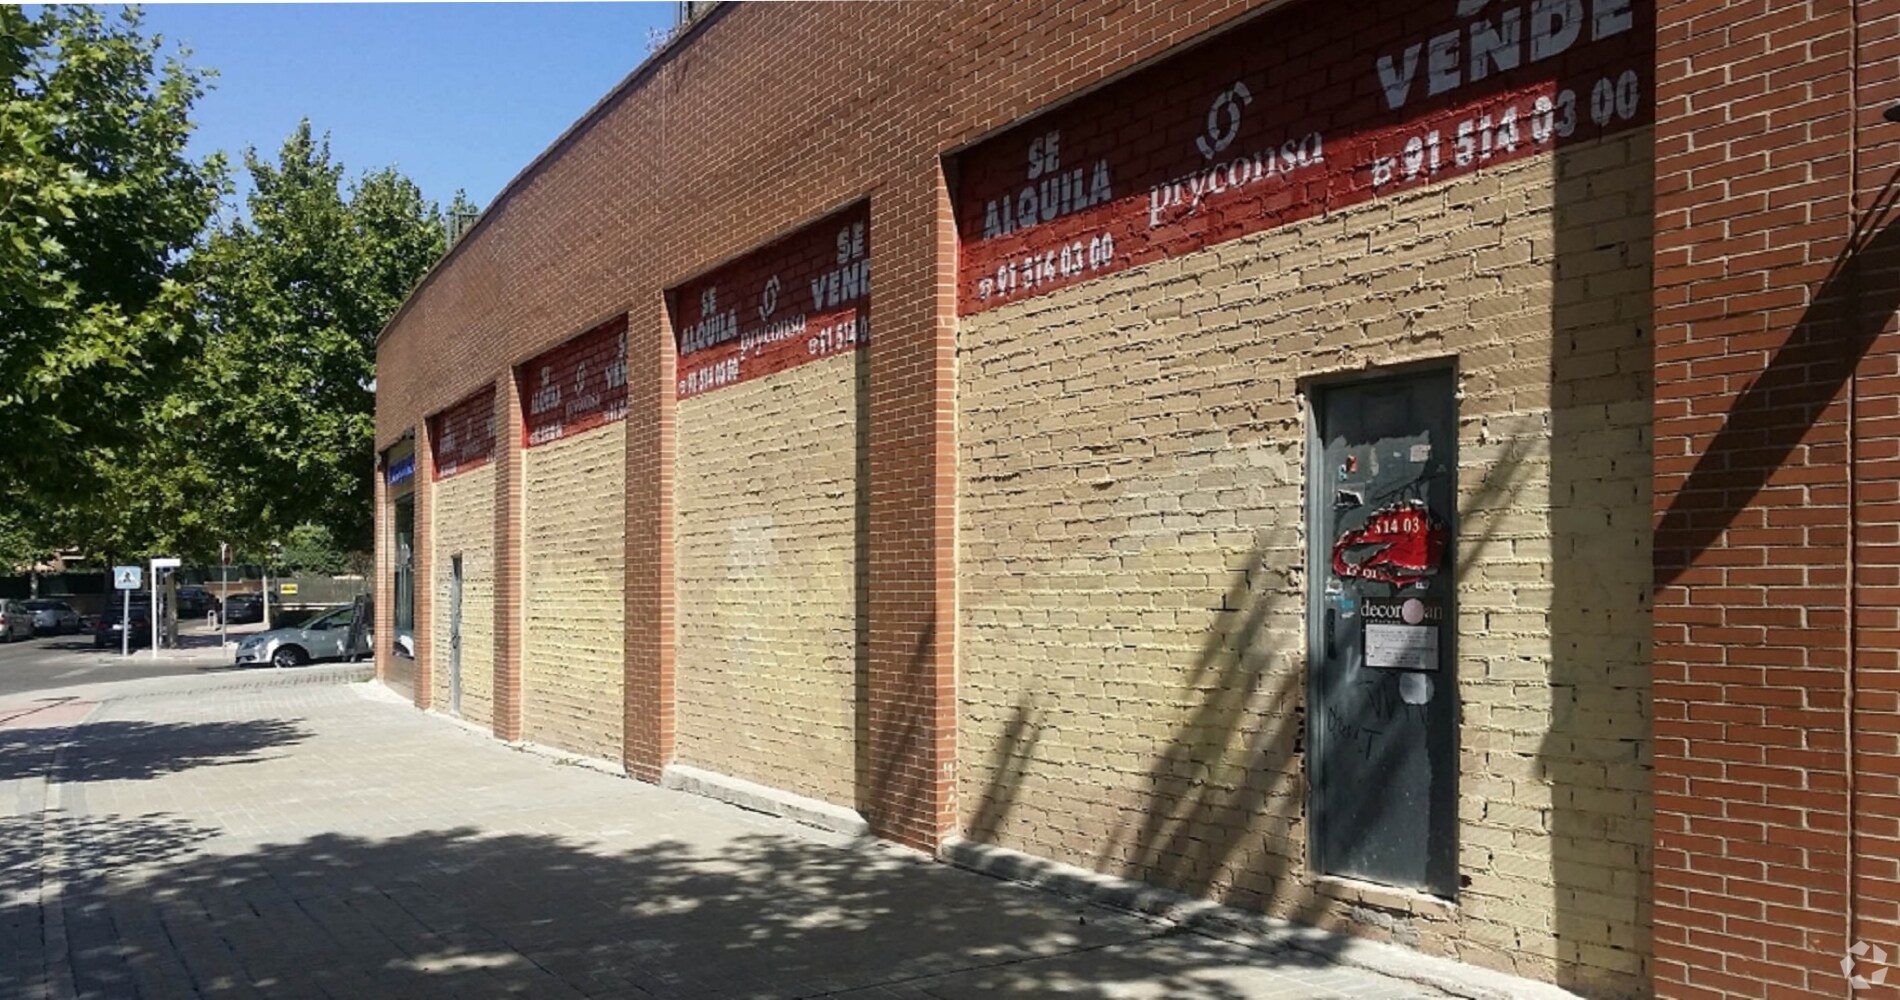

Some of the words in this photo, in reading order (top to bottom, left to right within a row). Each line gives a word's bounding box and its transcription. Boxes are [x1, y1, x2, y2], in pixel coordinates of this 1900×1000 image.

[1376, 0, 1634, 109] VENDE
[1404, 129, 1441, 181] 91
[1455, 106, 1519, 167] 514
[1531, 90, 1577, 143] 03
[1590, 70, 1640, 126] 00
[1028, 130, 1060, 179] SE
[1149, 131, 1325, 228] pryconsa
[983, 159, 1112, 240] ALQUILA
[837, 221, 866, 264] SE
[1023, 250, 1056, 289] 514
[1060, 241, 1083, 278] 03
[1089, 231, 1114, 270] 00
[702, 286, 717, 317] SE
[680, 308, 738, 356] ALQUILA
[1403, 517, 1420, 533] 03
